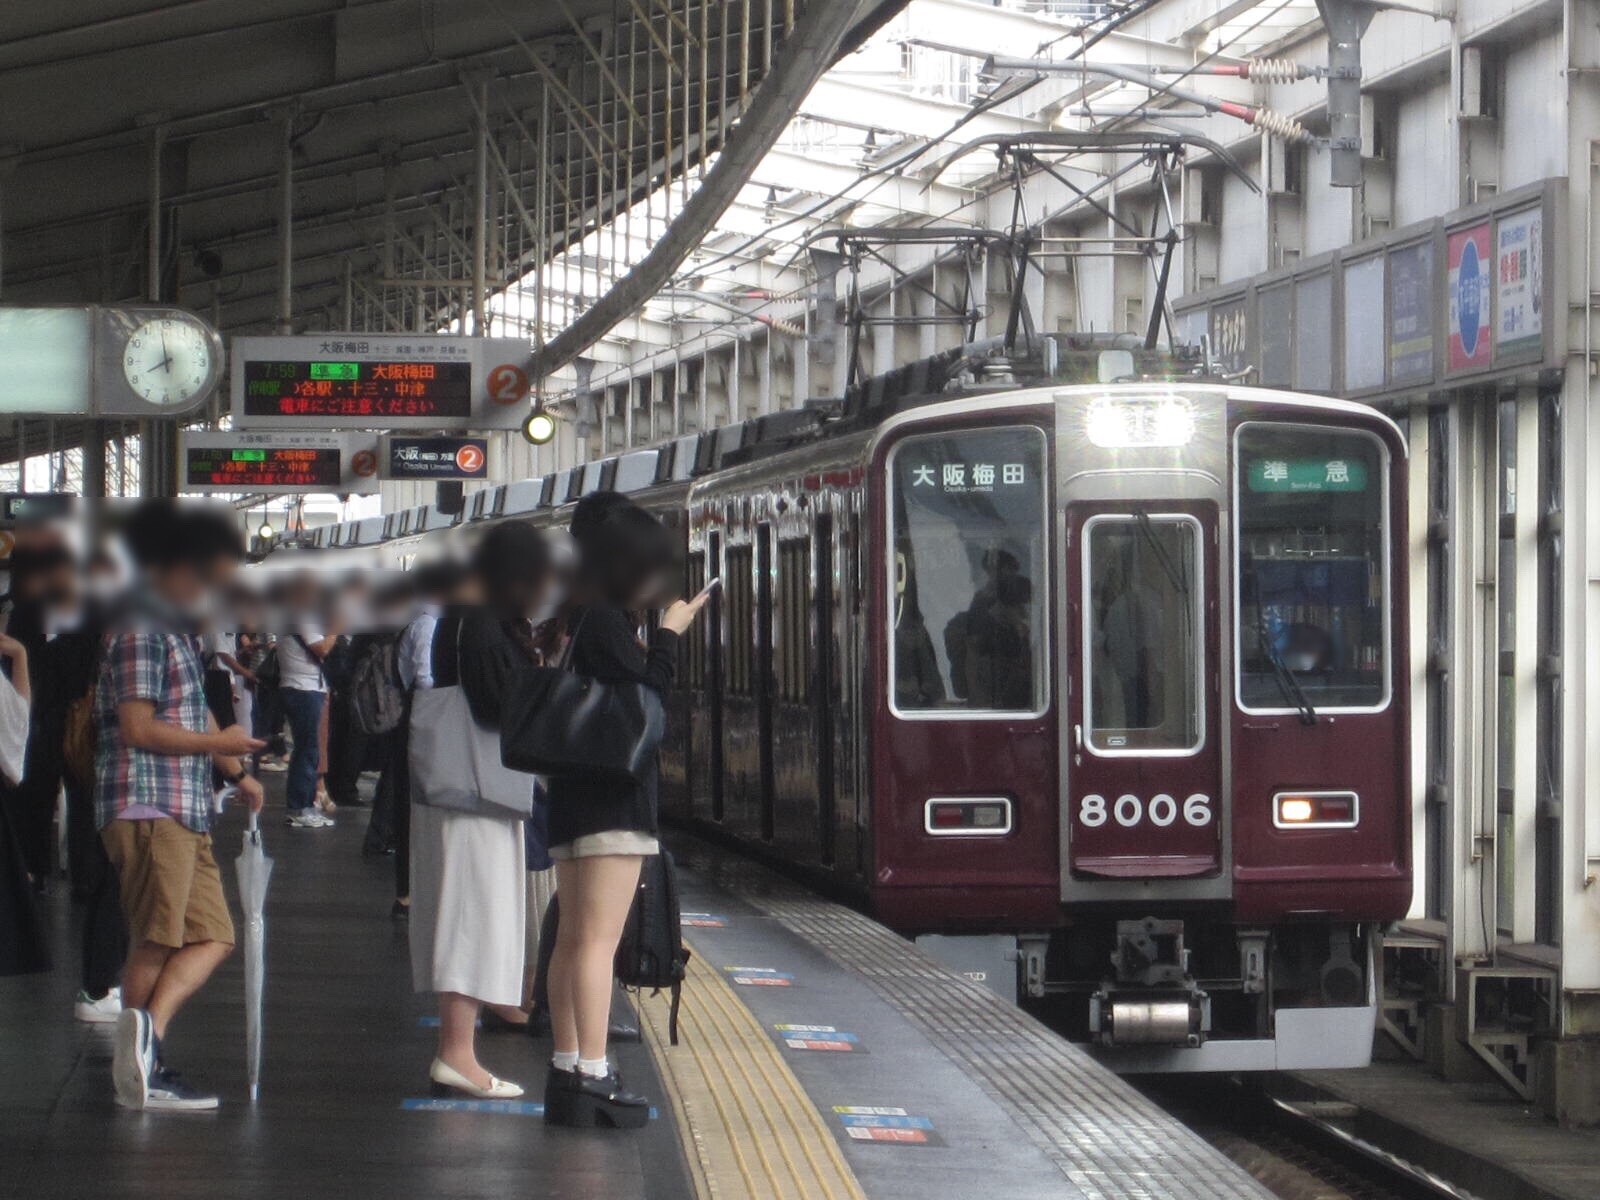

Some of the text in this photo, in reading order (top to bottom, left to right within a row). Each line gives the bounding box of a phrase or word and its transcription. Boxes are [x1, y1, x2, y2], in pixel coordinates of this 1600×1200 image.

[320, 342, 369, 354] 大阪梅田
[264, 363, 295, 378] 7:59
[373, 364, 434, 379] 大阪梅田
[498, 370, 517, 399] 2
[464, 450, 477, 467] 2
[913, 464, 1024, 486] 大阪梅田
[1264, 461, 1349, 482] 準急
[1079, 793, 1211, 827] 8006
